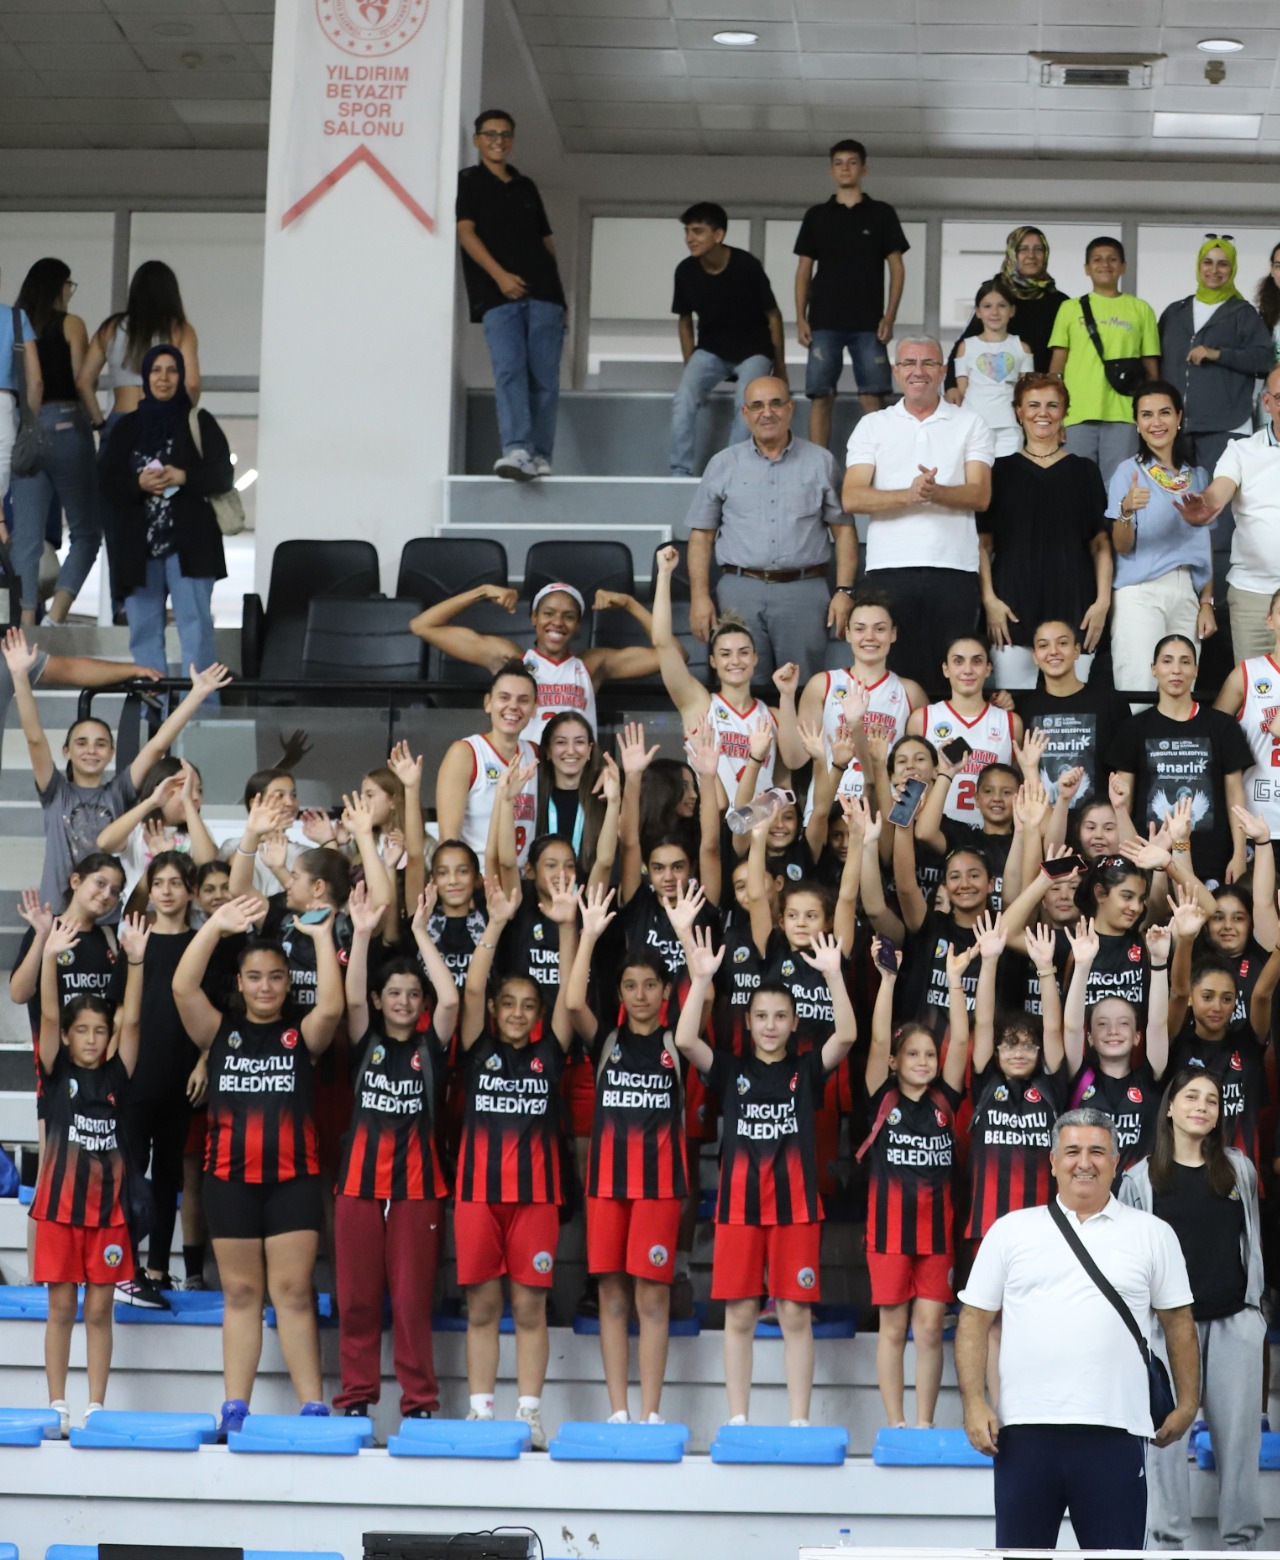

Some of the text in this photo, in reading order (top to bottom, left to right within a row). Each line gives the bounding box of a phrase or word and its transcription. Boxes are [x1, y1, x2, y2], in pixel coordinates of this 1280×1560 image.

[326, 65, 409, 81] YILDIRIM
[326, 83, 407, 99] BEYAZIT
[338, 102, 391, 118] SPOR
[323, 120, 403, 136] SALONU
[1156, 761, 1204, 774] #narin
[223, 1055, 294, 1074] TURGUTLU
[218, 1072, 296, 1092] BELEDİYESİ
[479, 1074, 549, 1094] TURGUTLU
[607, 1069, 673, 1090] TURGUTLU
[987, 1109, 1047, 1129] TURGUTLU
[984, 1129, 1051, 1147] BELEDİYESİ
